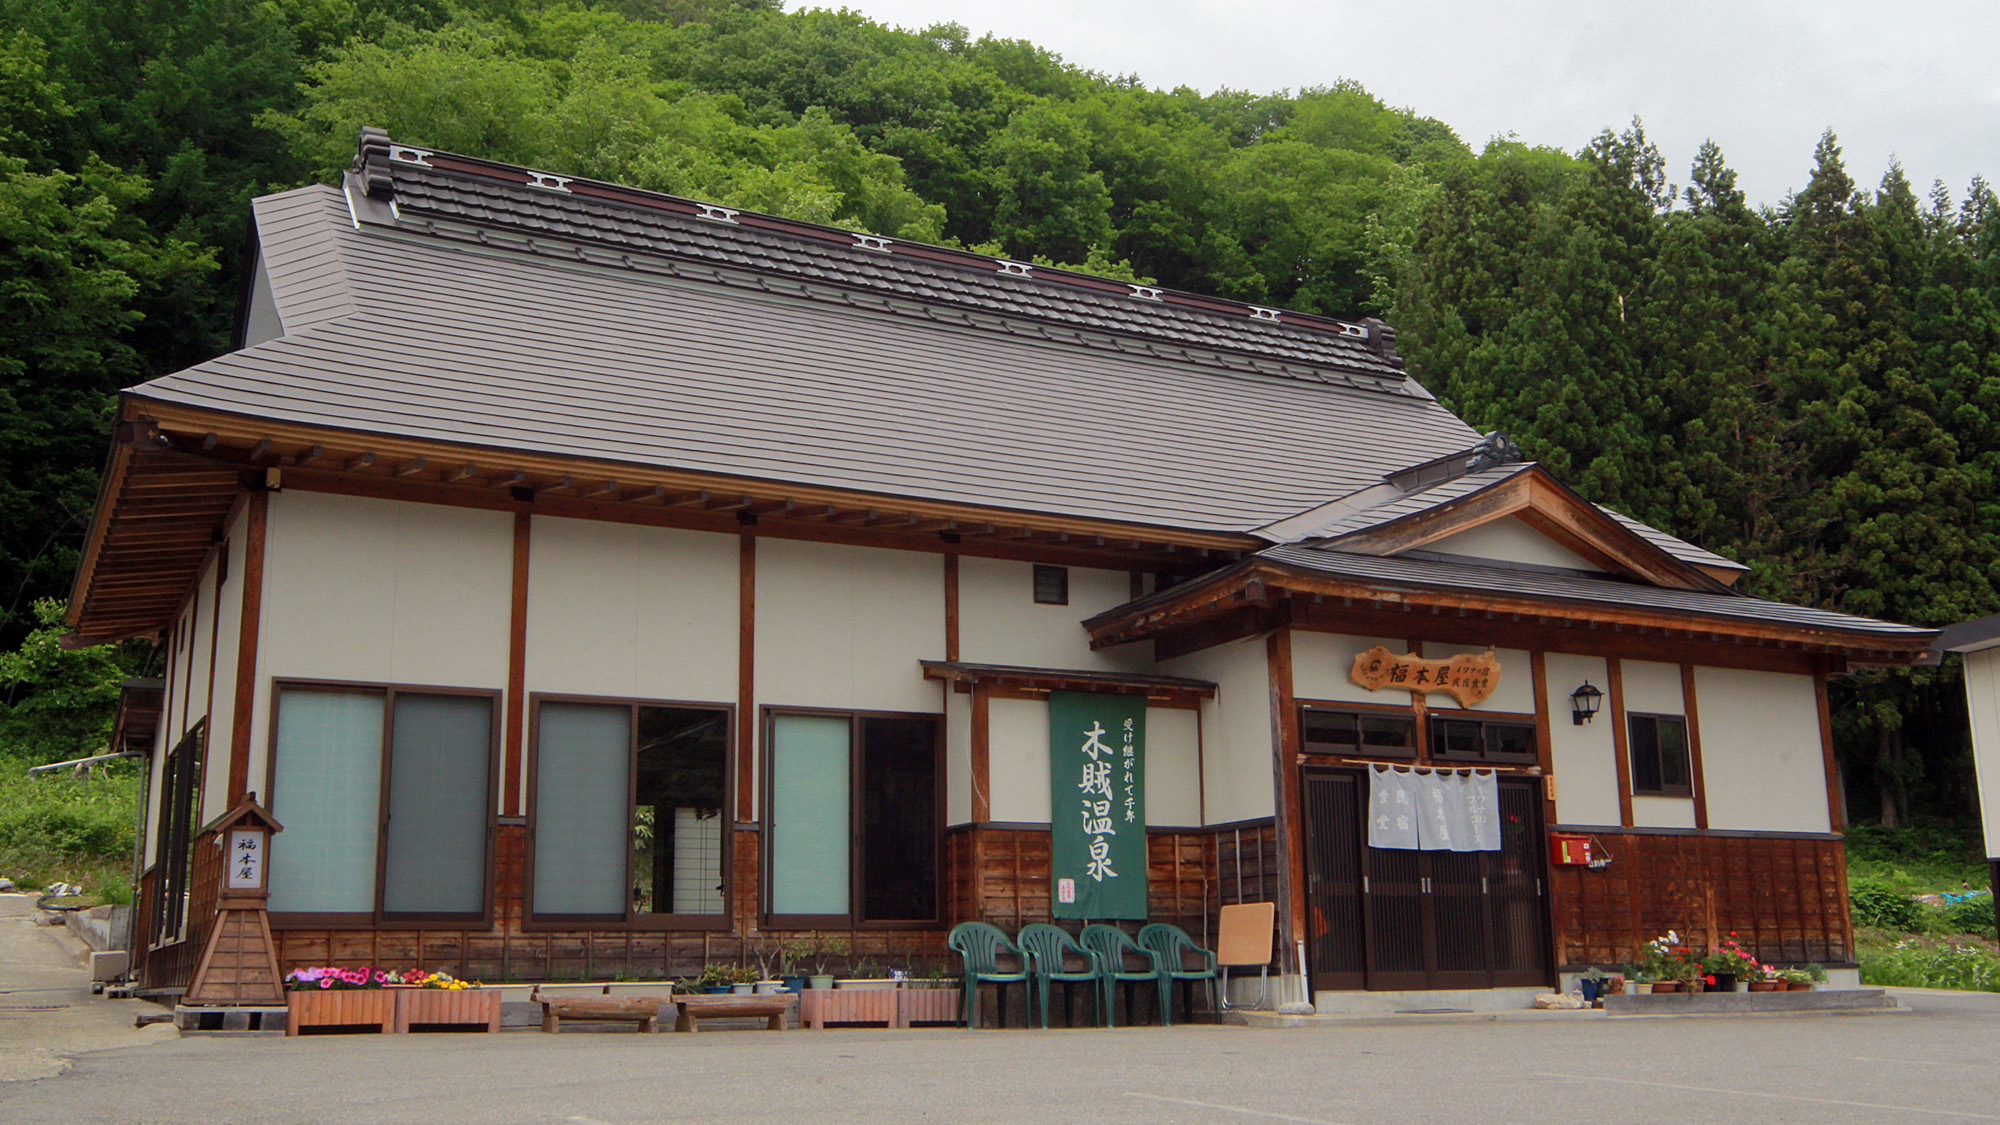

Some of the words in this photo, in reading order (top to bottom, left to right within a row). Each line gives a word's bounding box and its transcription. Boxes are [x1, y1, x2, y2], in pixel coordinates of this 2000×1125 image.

[1390, 663, 1450, 686] 福本屋
[1123, 718, 1136, 824] 受け継がれて千年
[1078, 720, 1119, 883] 木賊温泉
[1396, 788, 1409, 831] 民宿
[1432, 787, 1449, 841] 福本屋
[235, 838, 257, 880] 福本屋
